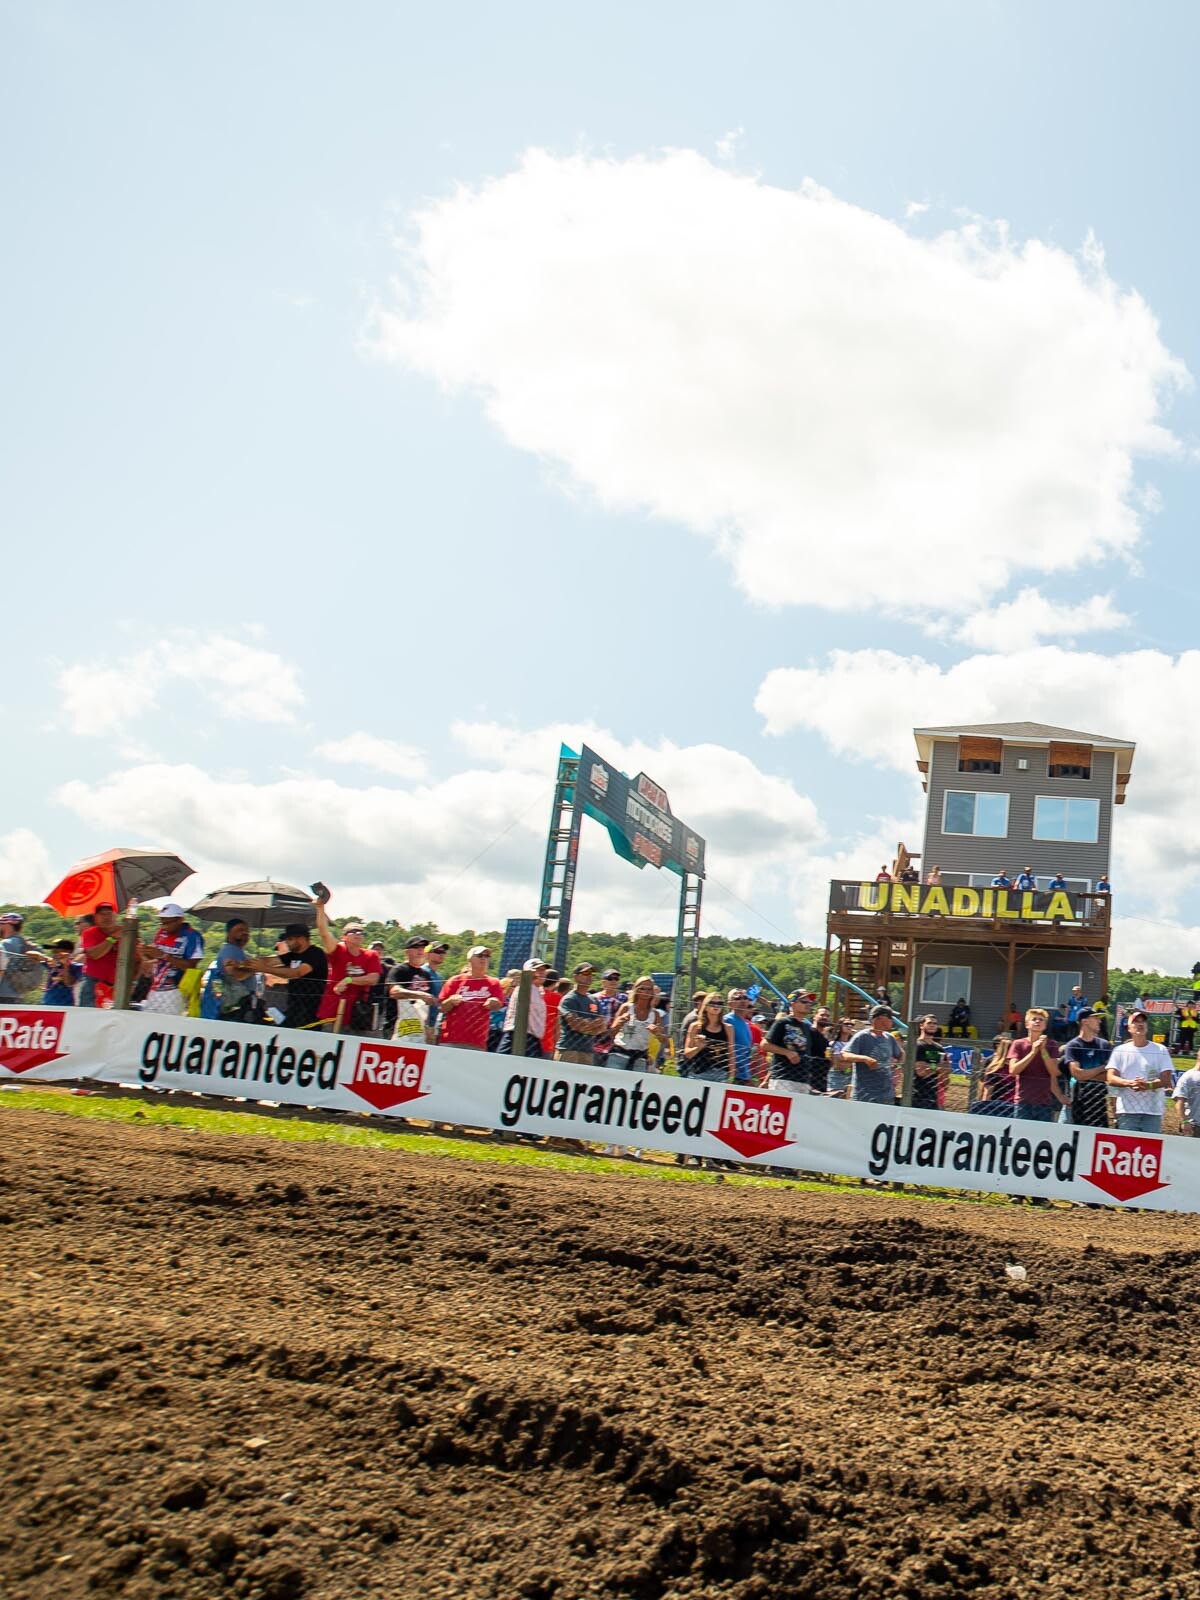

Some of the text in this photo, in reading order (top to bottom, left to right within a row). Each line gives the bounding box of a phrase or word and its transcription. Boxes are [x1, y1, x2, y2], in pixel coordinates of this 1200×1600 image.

[860, 881, 1075, 920] UNADILLA
[0, 1016, 58, 1050] Rate
[139, 1031, 420, 1091] guaranteed Rate
[500, 1074, 785, 1138] guaranteed Rate
[868, 1123, 1158, 1182] guaranteed Rate
